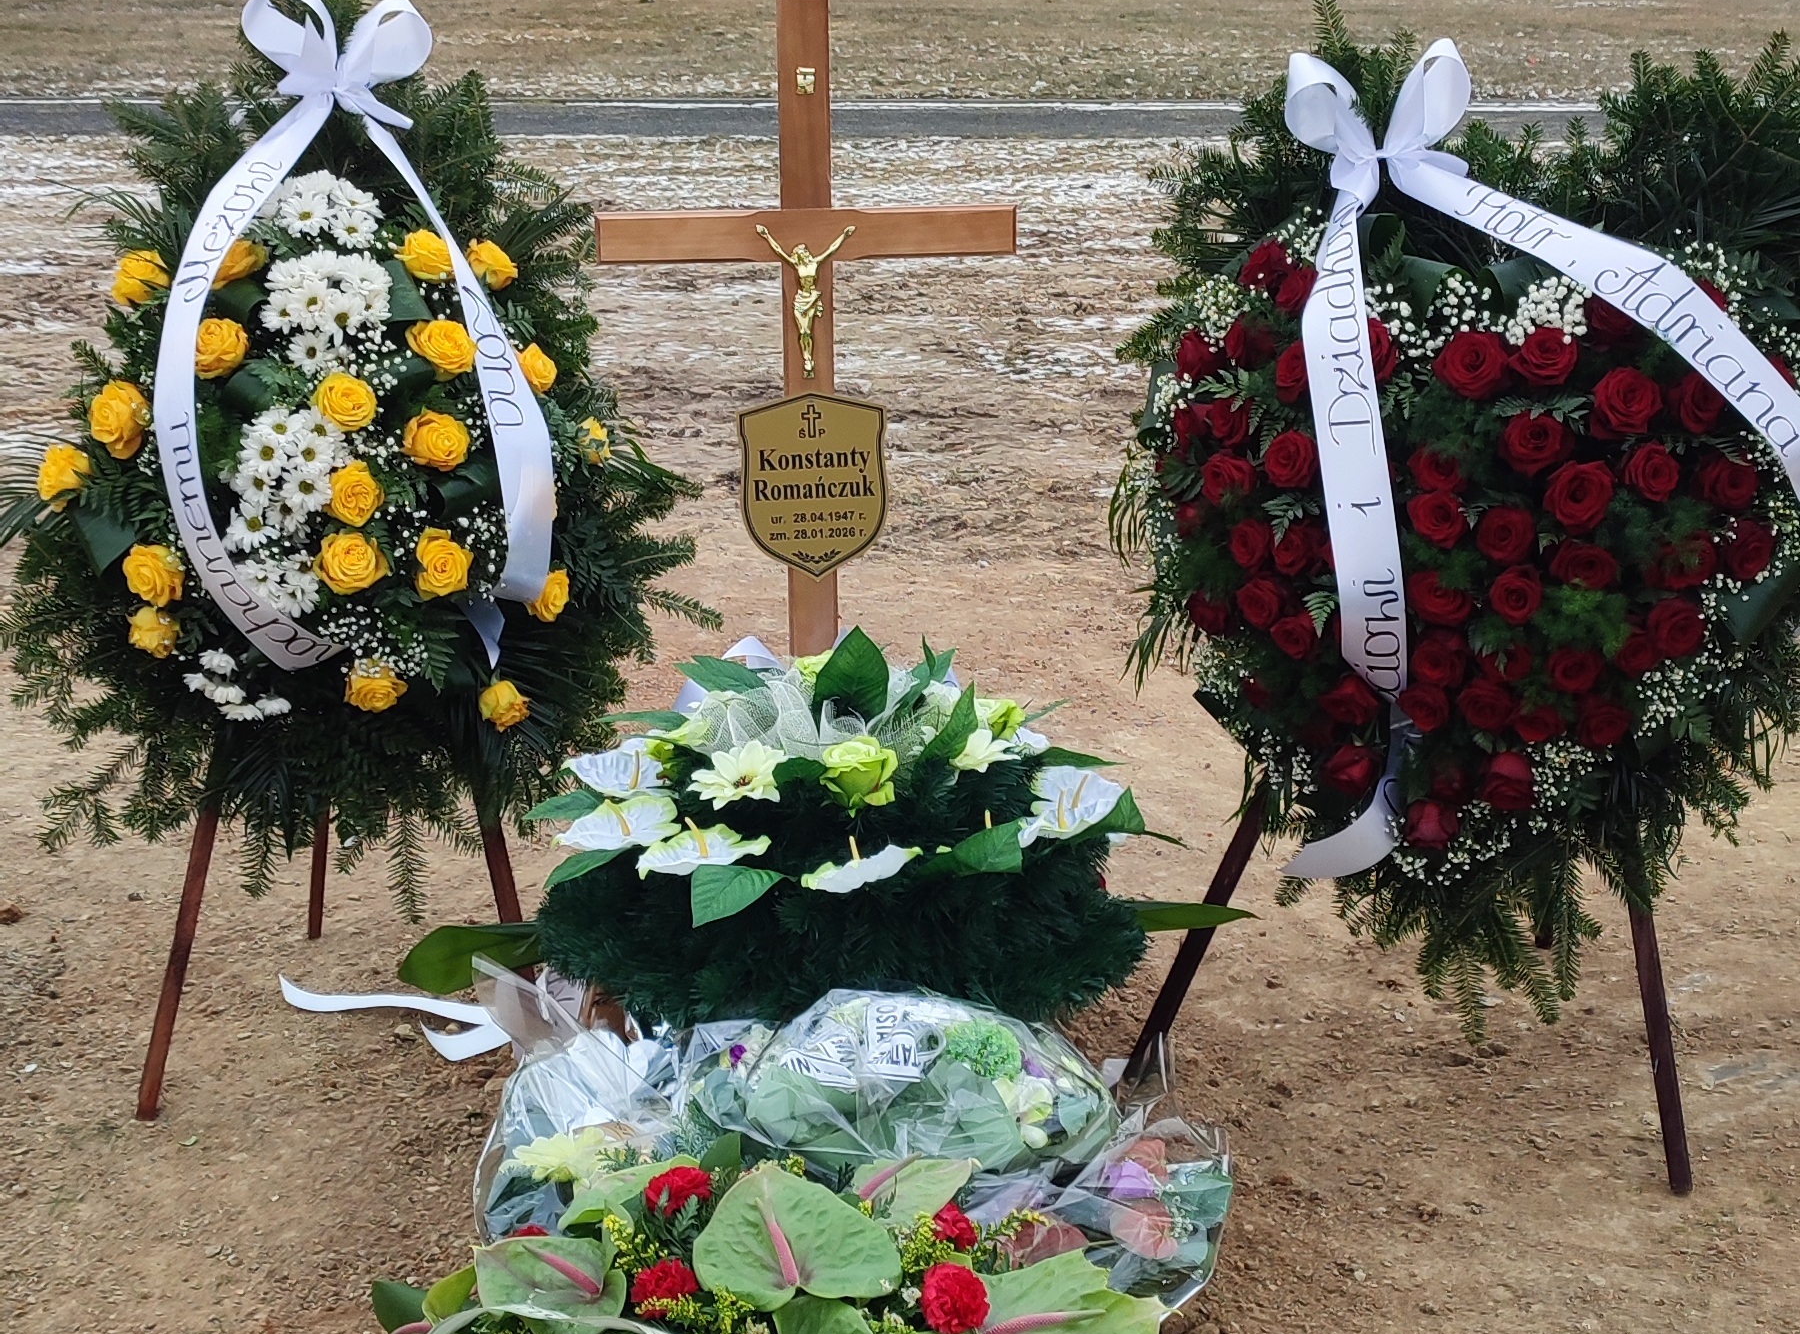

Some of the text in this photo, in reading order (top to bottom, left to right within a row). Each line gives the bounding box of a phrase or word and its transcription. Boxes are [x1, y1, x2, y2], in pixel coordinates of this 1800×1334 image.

[1593, 262, 1800, 458] Adriana
[818, 428, 826, 438] P
[758, 446, 871, 474] Konstanty
[753, 475, 876, 502] Romańczuk
[770, 510, 867, 525] ur. 28.04.1947 r.
[1336, 495, 1383, 518] i
[768, 526, 867, 542] zm. 28.01.2026 r.
